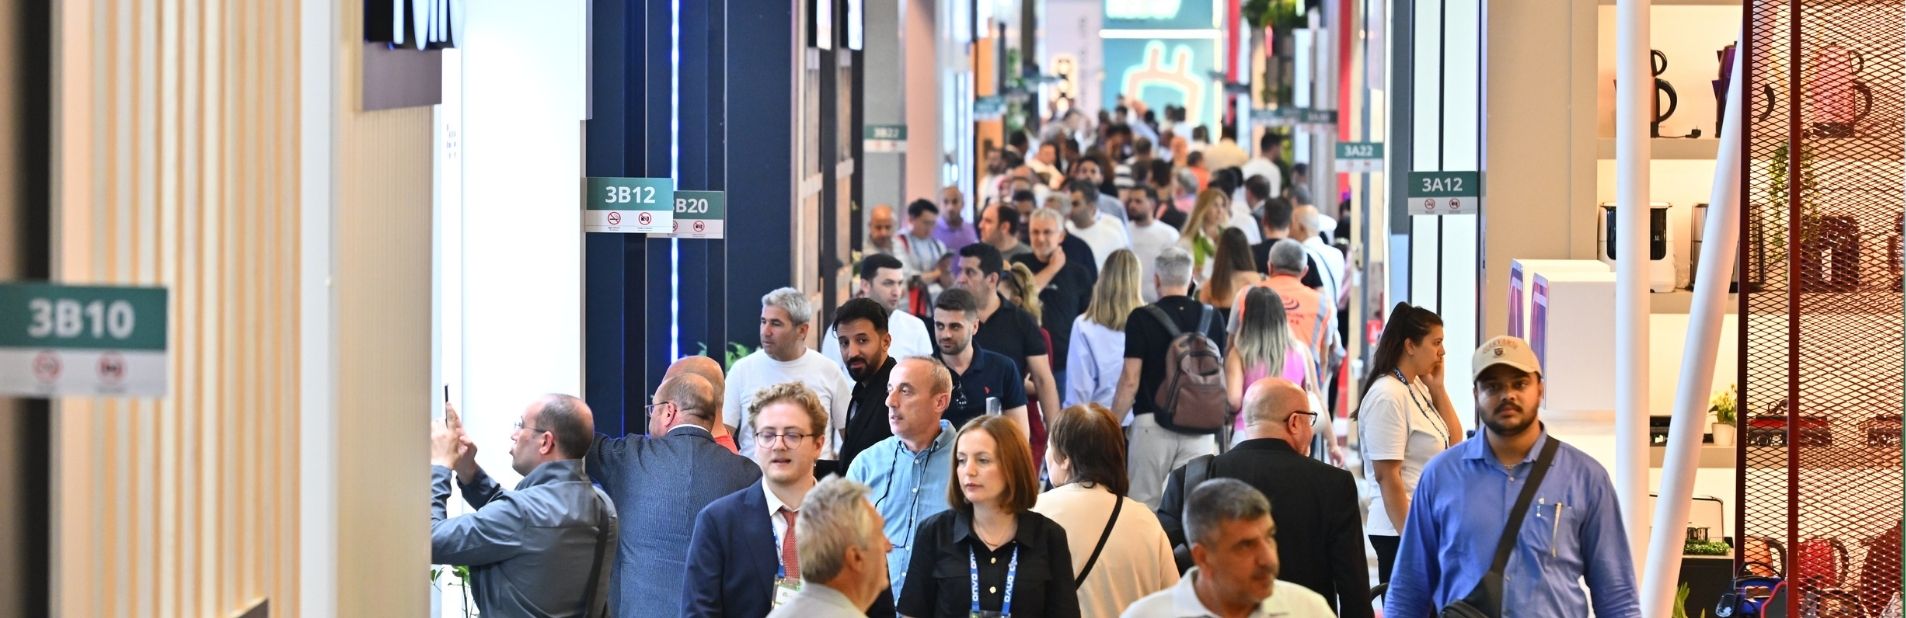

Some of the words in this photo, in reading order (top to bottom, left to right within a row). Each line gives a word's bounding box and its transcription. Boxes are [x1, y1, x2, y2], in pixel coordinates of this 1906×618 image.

[1345, 146, 1373, 156] 3A22
[1422, 177, 1463, 192] 3A12
[605, 186, 655, 204] 3B12
[673, 198, 709, 214] B20
[27, 298, 135, 339] 3B10
